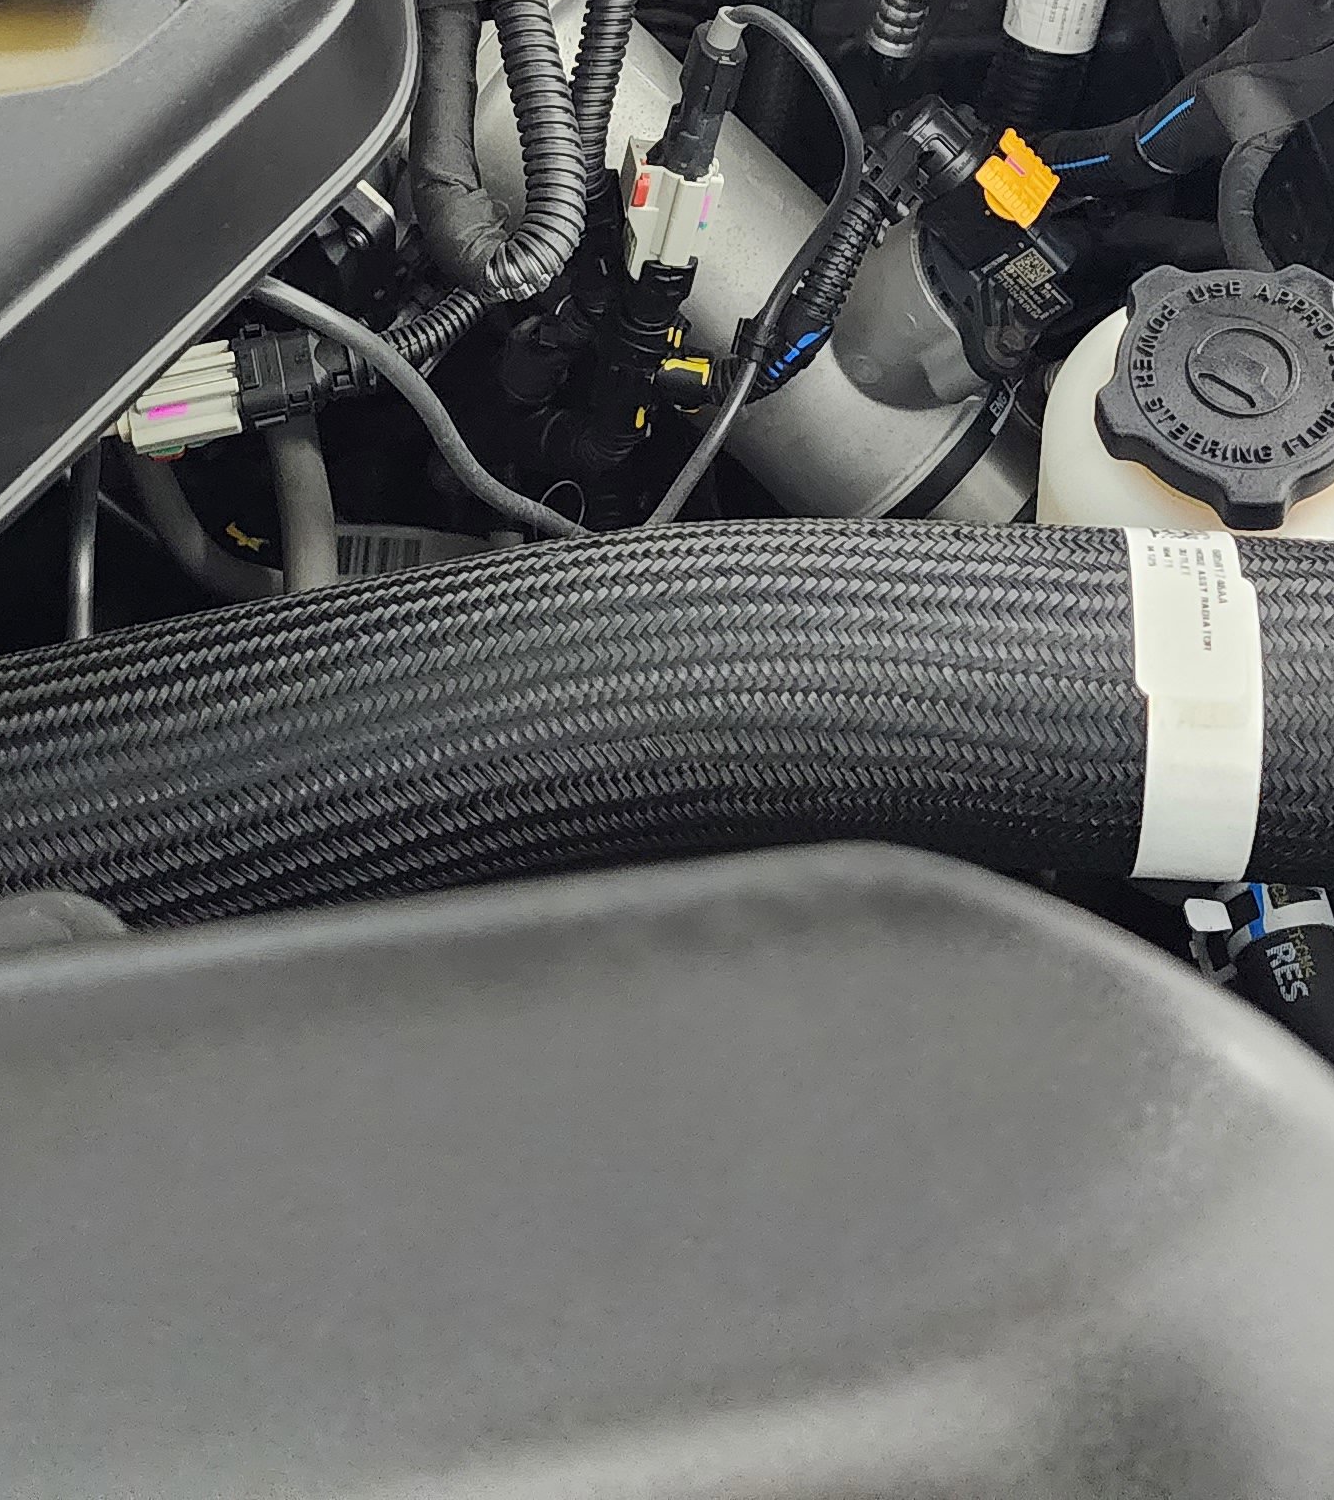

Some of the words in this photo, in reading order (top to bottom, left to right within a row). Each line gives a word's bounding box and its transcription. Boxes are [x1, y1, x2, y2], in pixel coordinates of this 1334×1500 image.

[1187, 279, 1243, 302] USE
[1131, 302, 1181, 390] POWER
[989, 390, 1009, 417] ENG
[1145, 395, 1276, 465] STEERING
[1264, 940, 1310, 1005] RES
